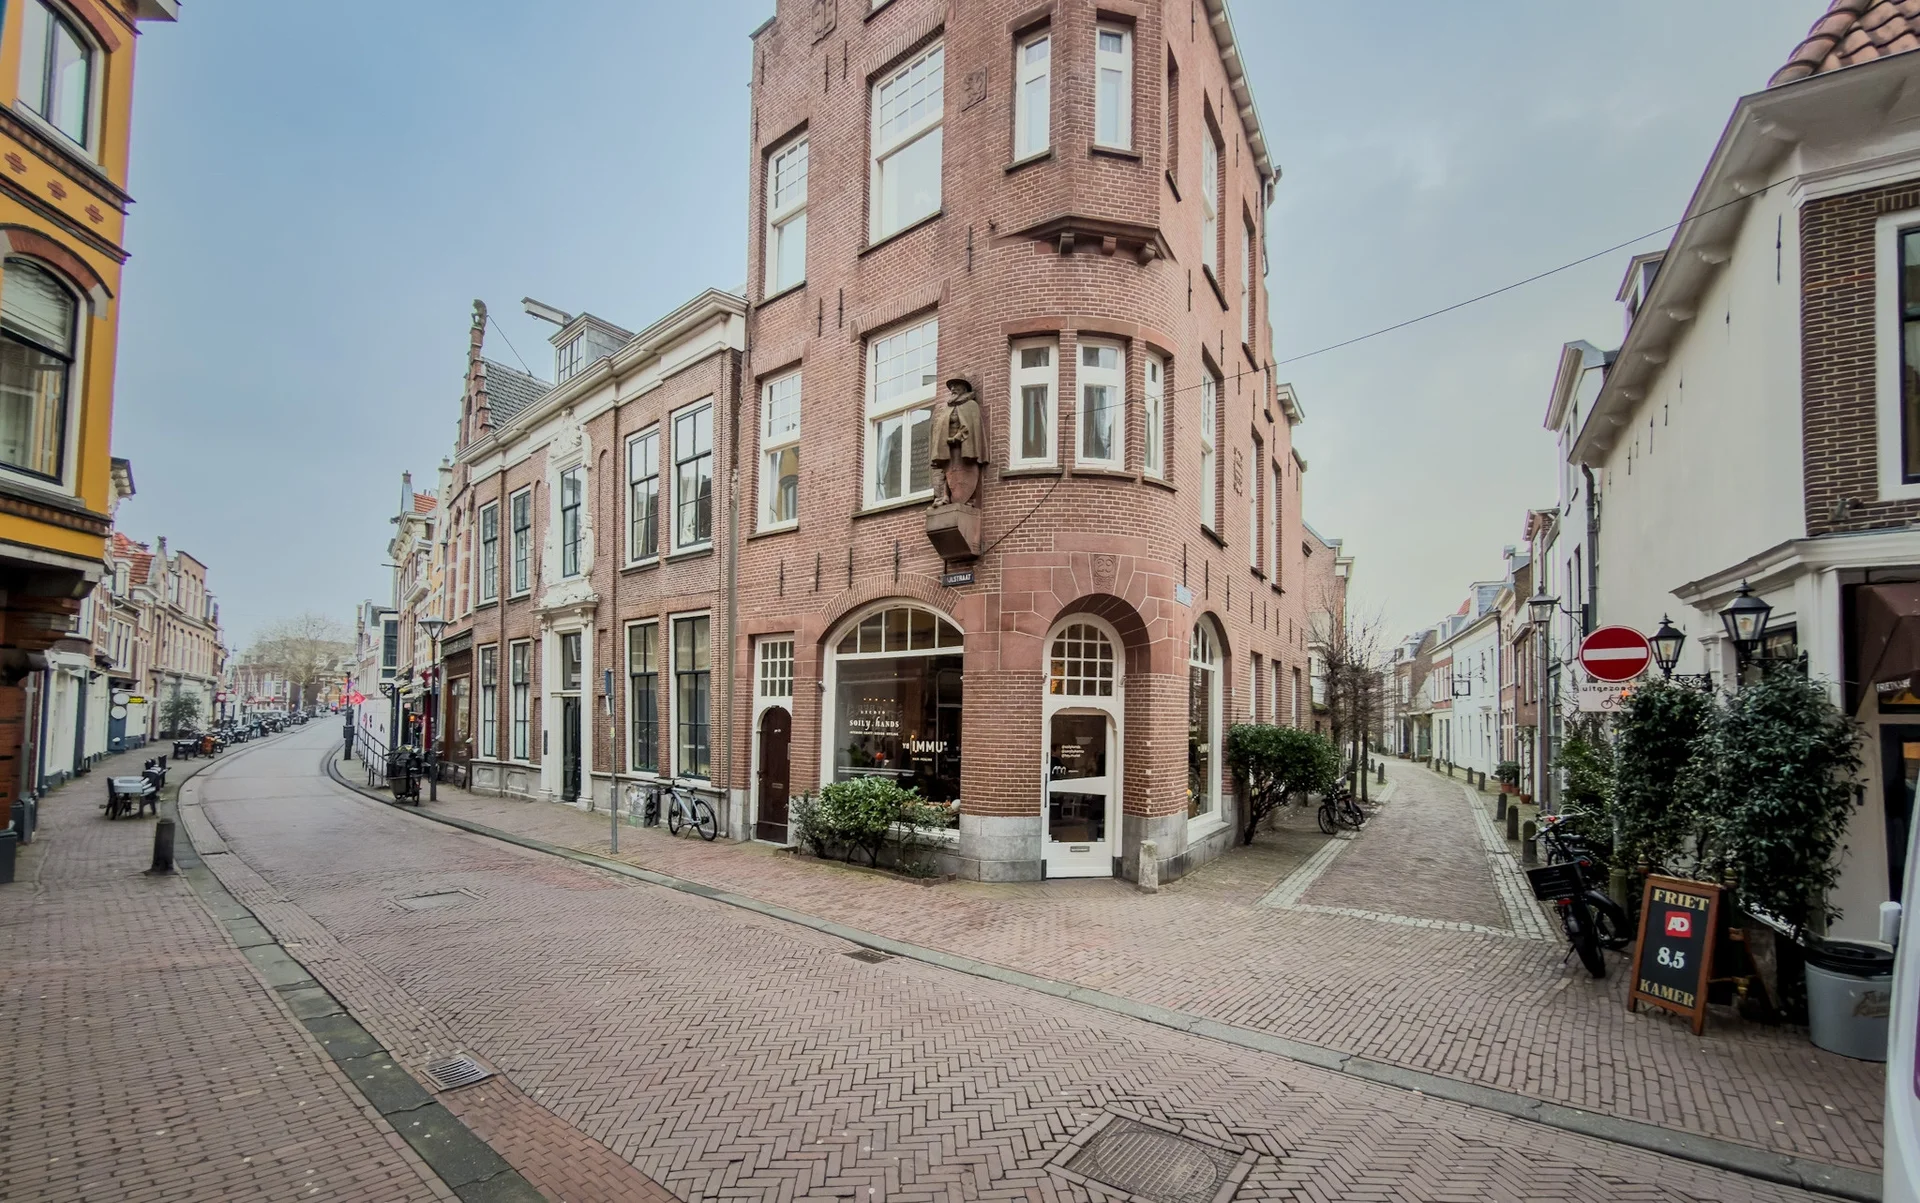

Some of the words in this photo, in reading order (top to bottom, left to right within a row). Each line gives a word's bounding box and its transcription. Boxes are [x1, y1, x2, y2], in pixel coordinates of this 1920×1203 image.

[1582, 685, 1640, 693] uitgezonde
[1653, 888, 1709, 911] FRIET
[1667, 916, 1690, 932] AD
[1657, 946, 1685, 969] 8,5
[1640, 979, 1694, 1007] KAMER
